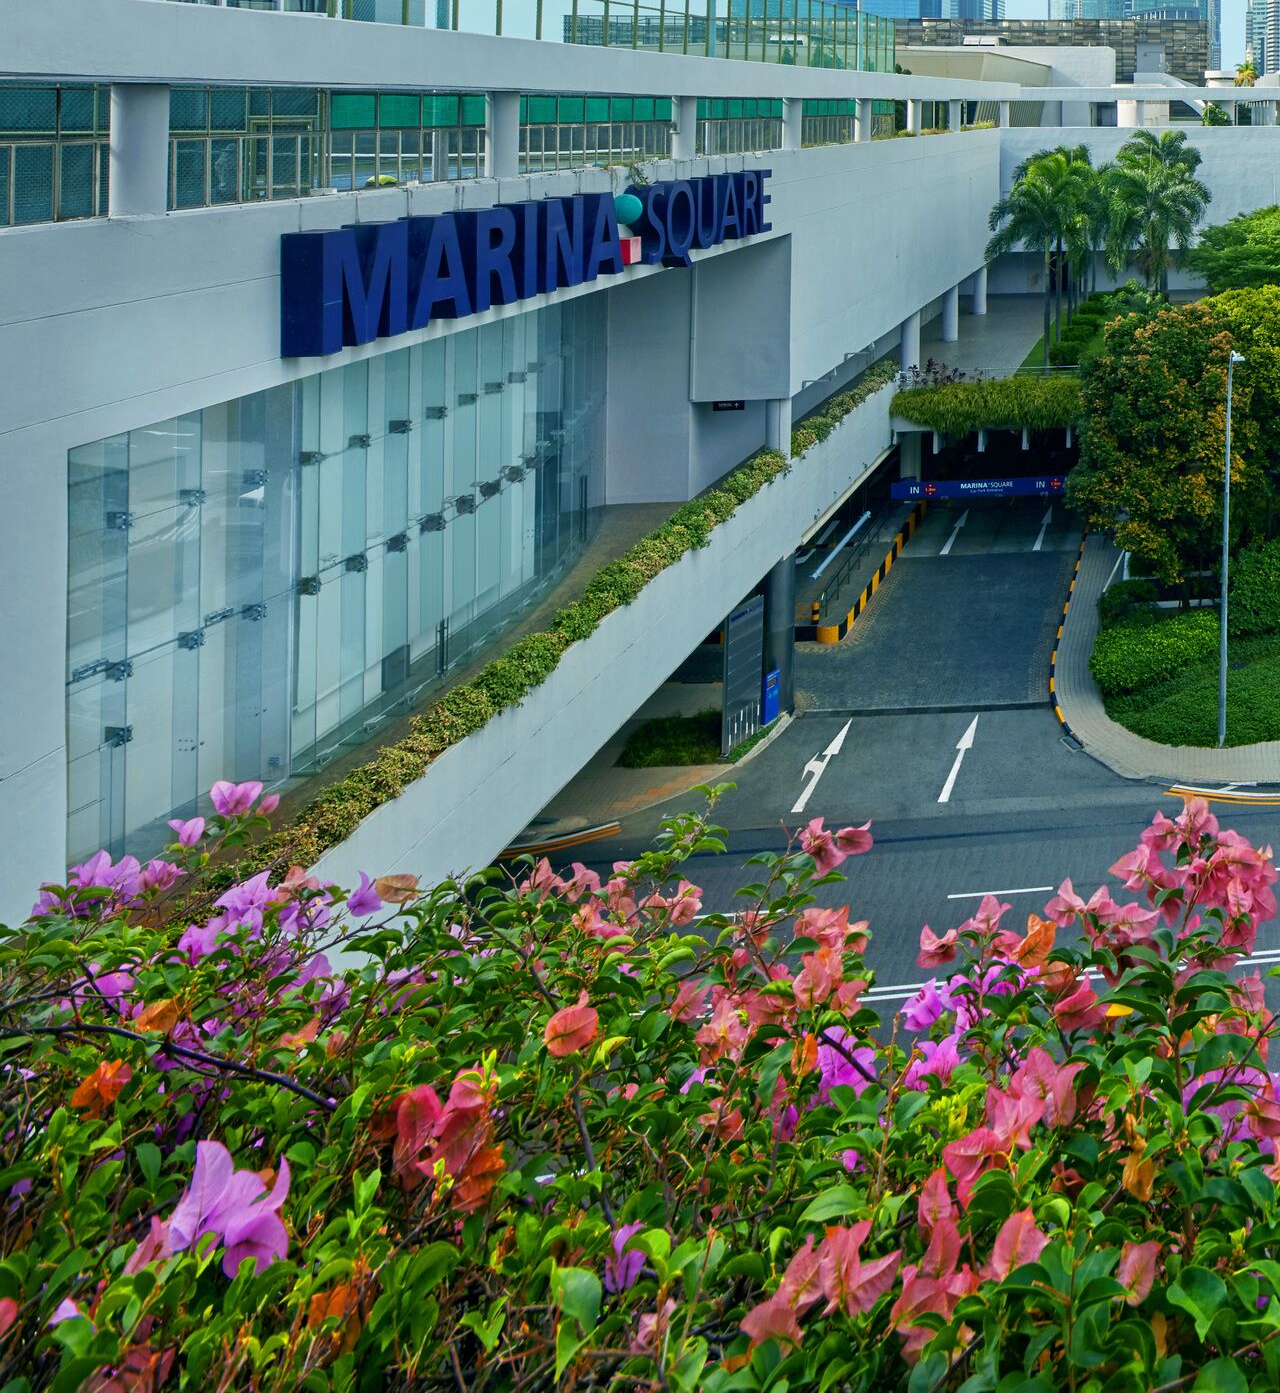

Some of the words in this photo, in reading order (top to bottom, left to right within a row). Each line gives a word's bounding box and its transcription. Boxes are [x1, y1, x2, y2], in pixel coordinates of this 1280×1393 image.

[281, 191, 625, 358] MARINA
[640, 169, 772, 267] SQUARE
[990, 480, 1014, 488] SQUARE
[1035, 481, 1046, 489] IN
[909, 486, 920, 495] IN
